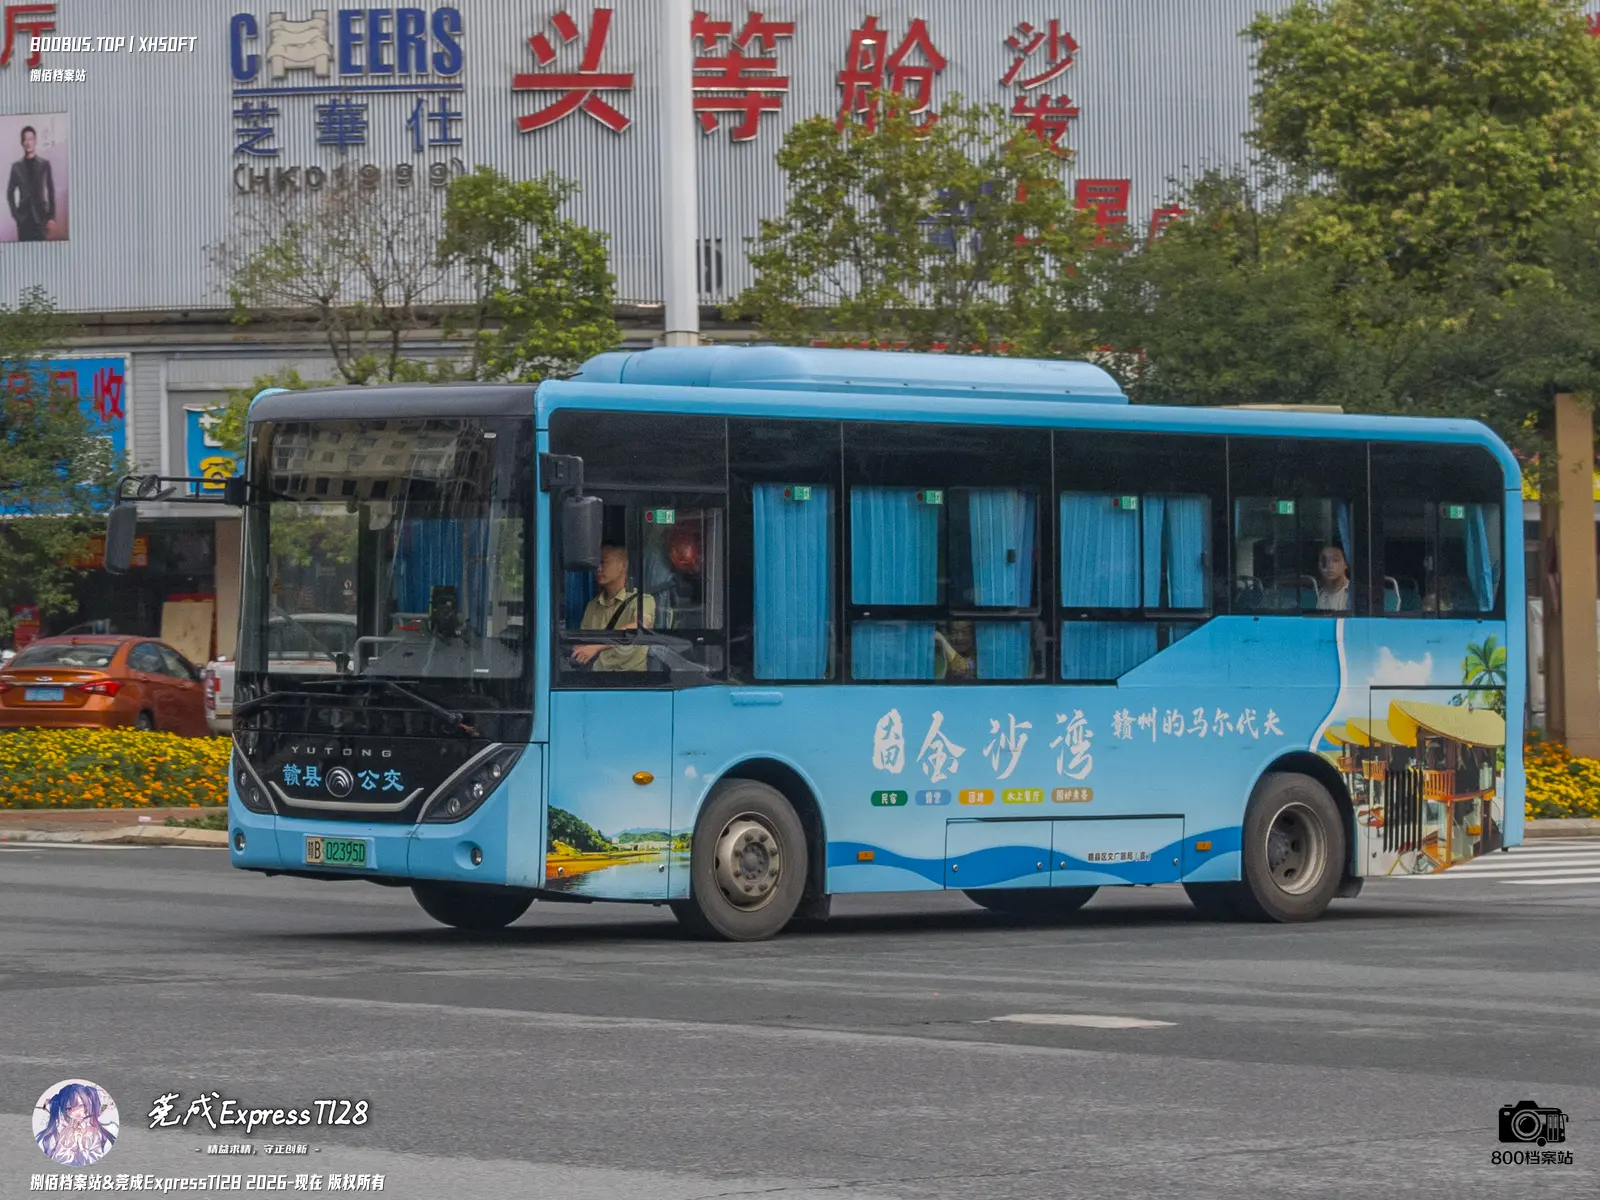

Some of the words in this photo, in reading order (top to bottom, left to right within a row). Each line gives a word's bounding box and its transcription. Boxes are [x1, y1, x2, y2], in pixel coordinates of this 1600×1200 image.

[1111, 707, 1284, 743] 赣州的马尔代夫
[292, 746, 392, 757] YUTONG
[283, 764, 322, 787] 赣县
[357, 769, 405, 791] 公交
